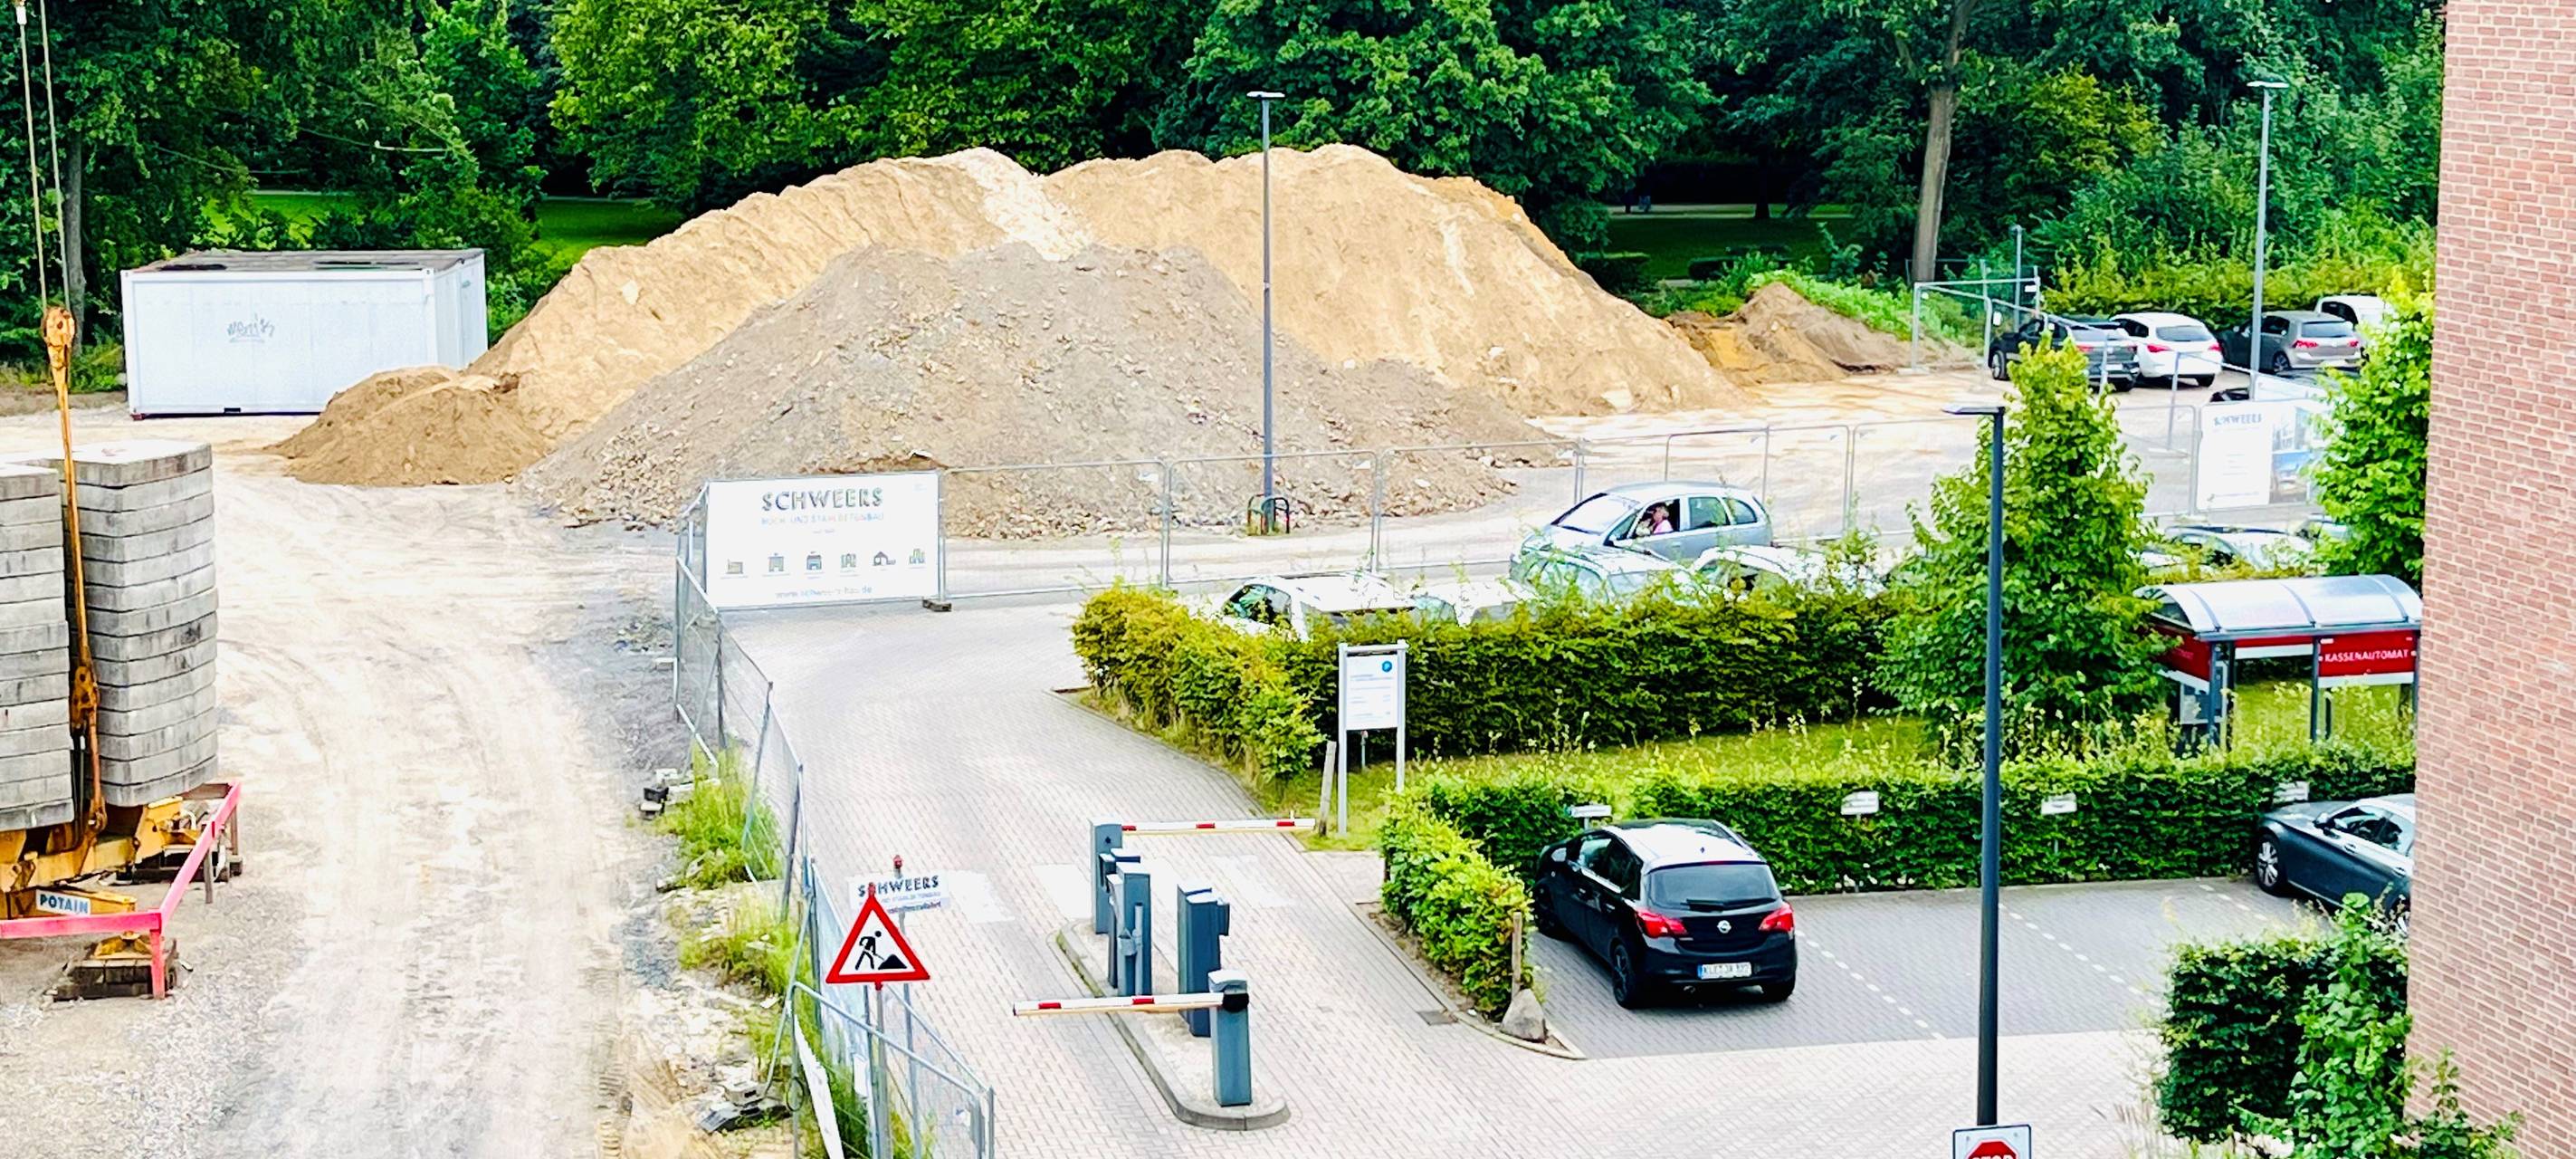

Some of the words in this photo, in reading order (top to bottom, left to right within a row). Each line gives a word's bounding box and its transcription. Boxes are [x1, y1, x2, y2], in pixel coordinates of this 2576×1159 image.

[761, 487, 883, 512] SCHWEERS
[2324, 649, 2409, 663] KASSENAUTOMAT
[858, 875, 939, 897] SHWEERS
[40, 894, 88, 914] POTAIN
